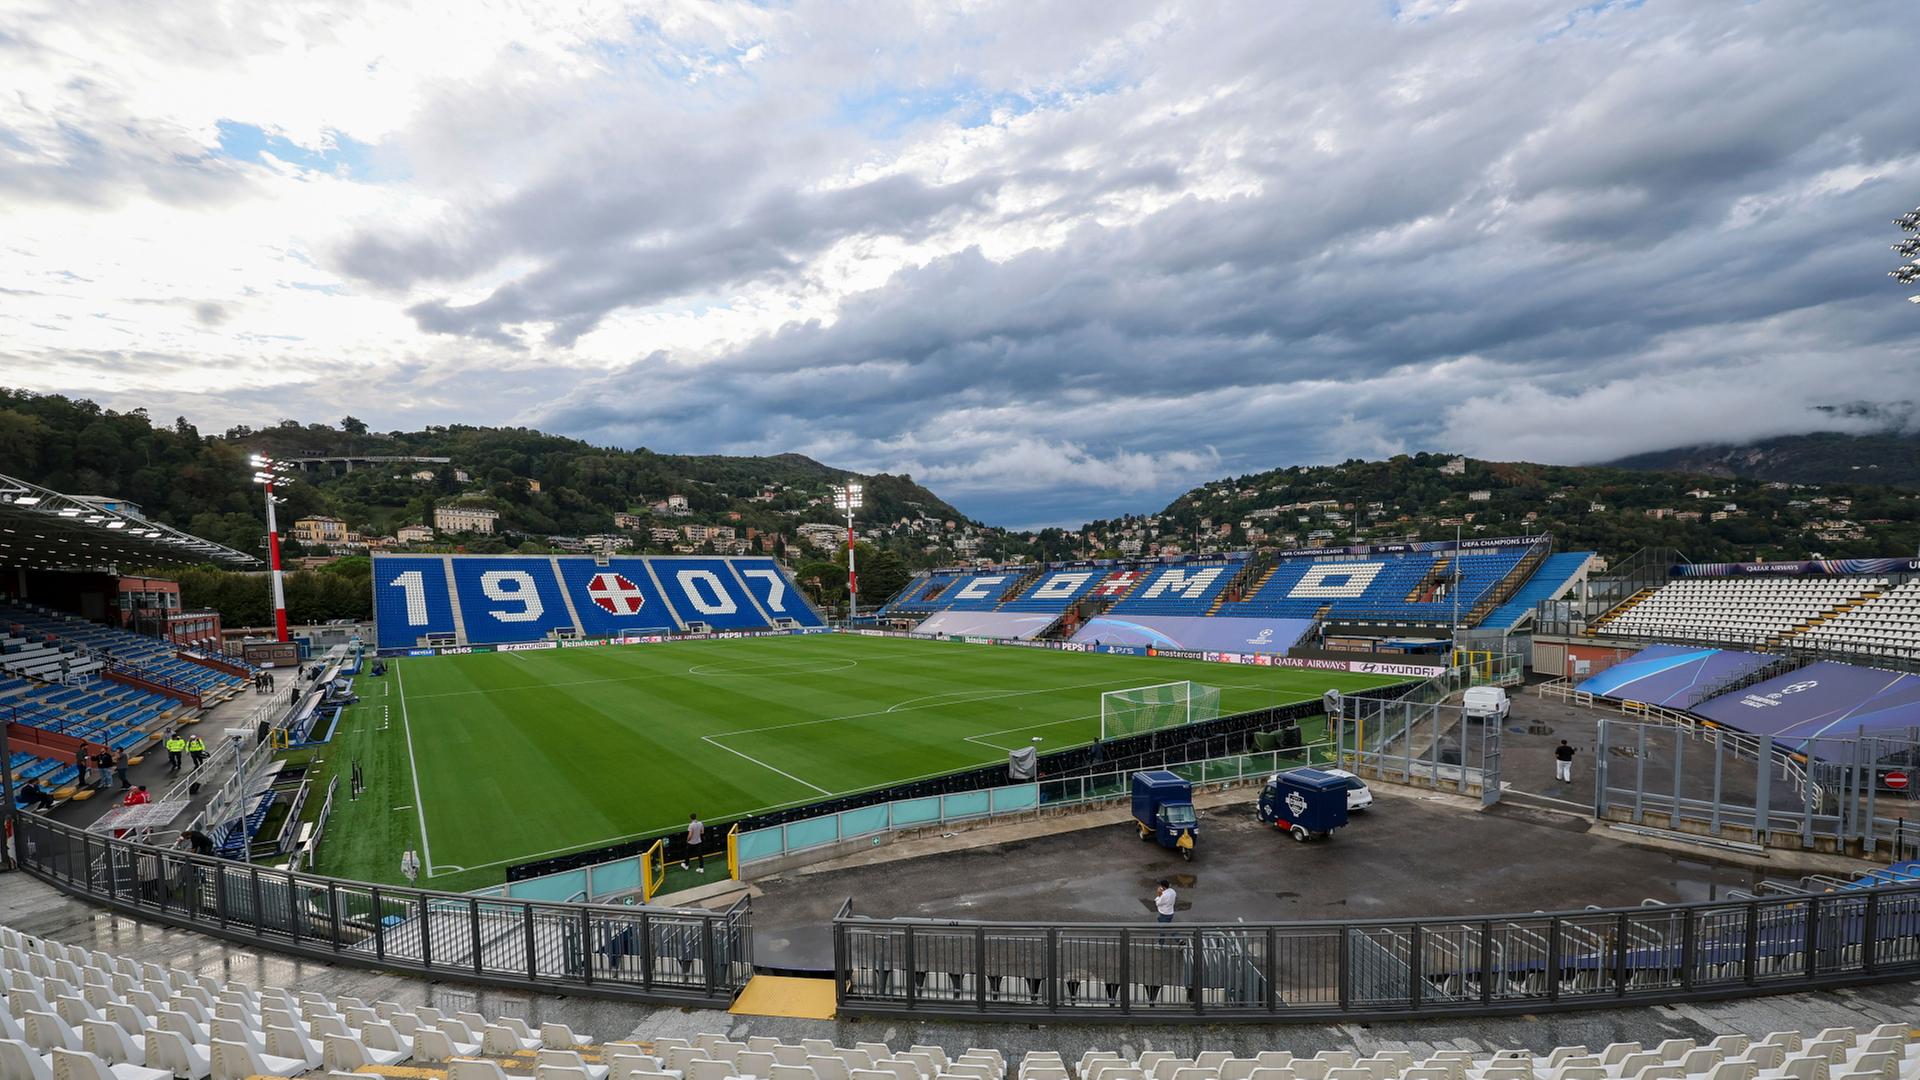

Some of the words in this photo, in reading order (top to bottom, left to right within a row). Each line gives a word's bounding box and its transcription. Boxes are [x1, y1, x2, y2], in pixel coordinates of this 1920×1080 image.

[1480, 538, 1520, 547] CHAMPIONS
[561, 640, 599, 648] Heineken
[1062, 642, 1085, 652] PEPSI
[441, 646, 472, 655] bet365
[1158, 650, 1201, 659] mastercard
[1274, 657, 1304, 667] QATAR
[1306, 659, 1346, 670] AIRWAYS
[1381, 666, 1434, 676] HYUNDAI
